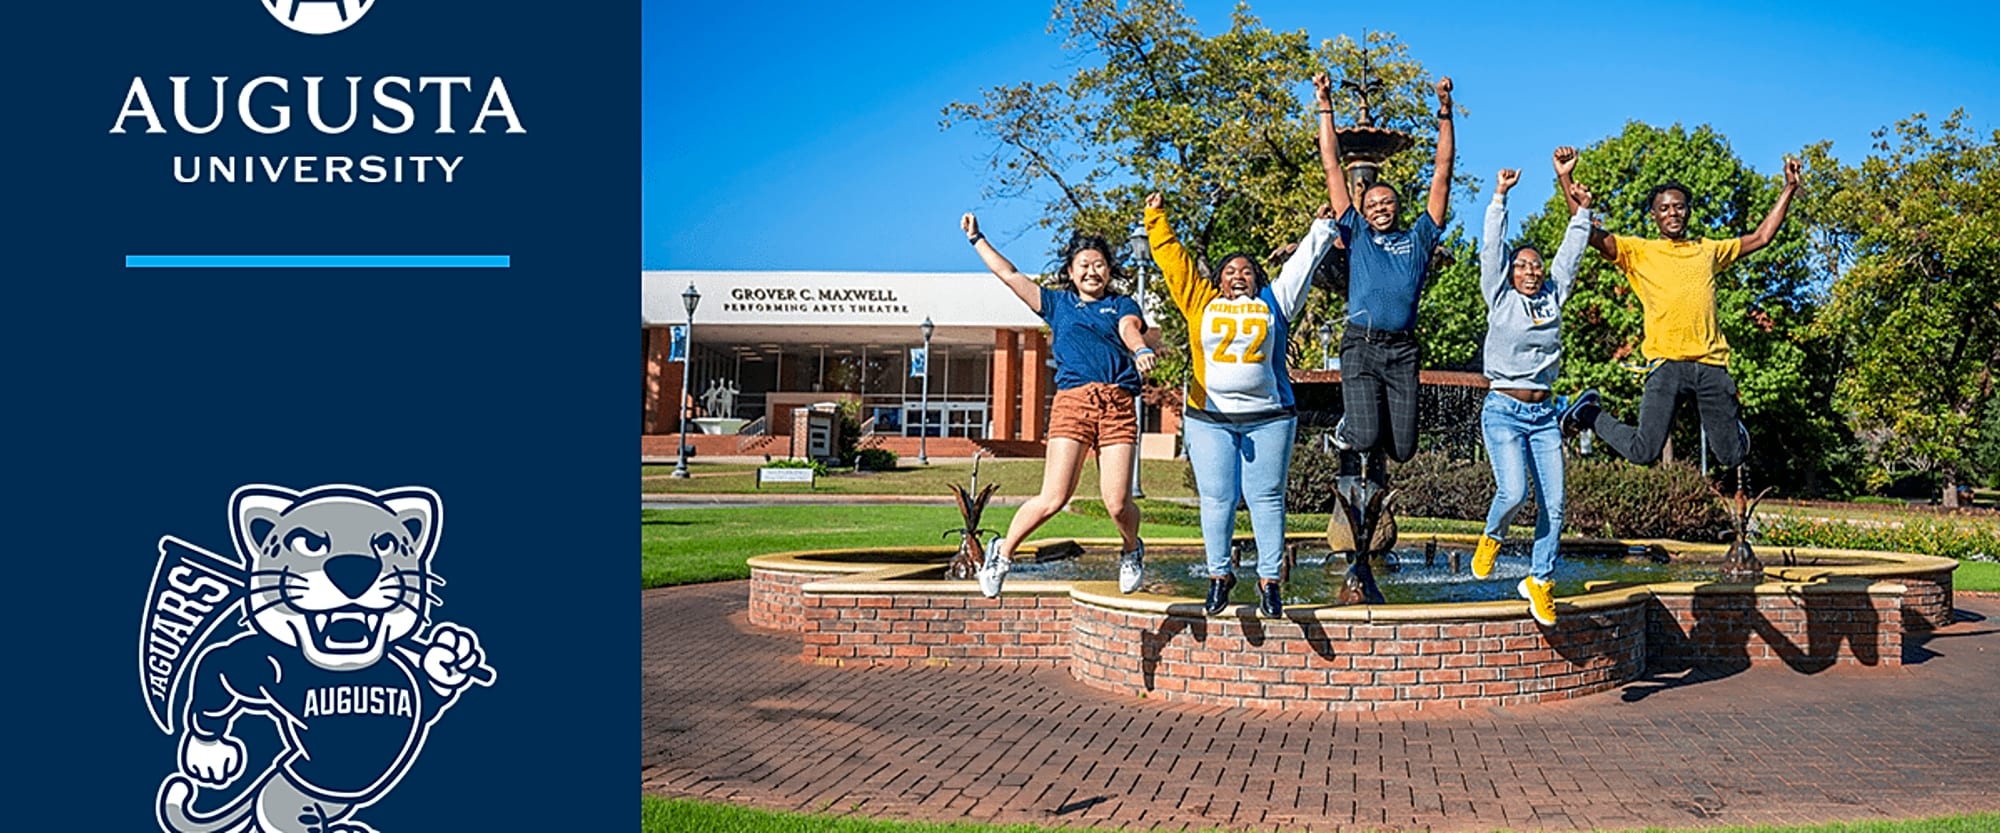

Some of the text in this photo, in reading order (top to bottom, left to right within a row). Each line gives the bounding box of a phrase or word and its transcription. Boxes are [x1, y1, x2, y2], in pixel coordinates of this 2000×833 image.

[731, 288, 898, 302] GROVER C. MAXWELL
[724, 304, 909, 313] PERFORMING ARTS THEATRE
[1211, 316, 1268, 364] 22
